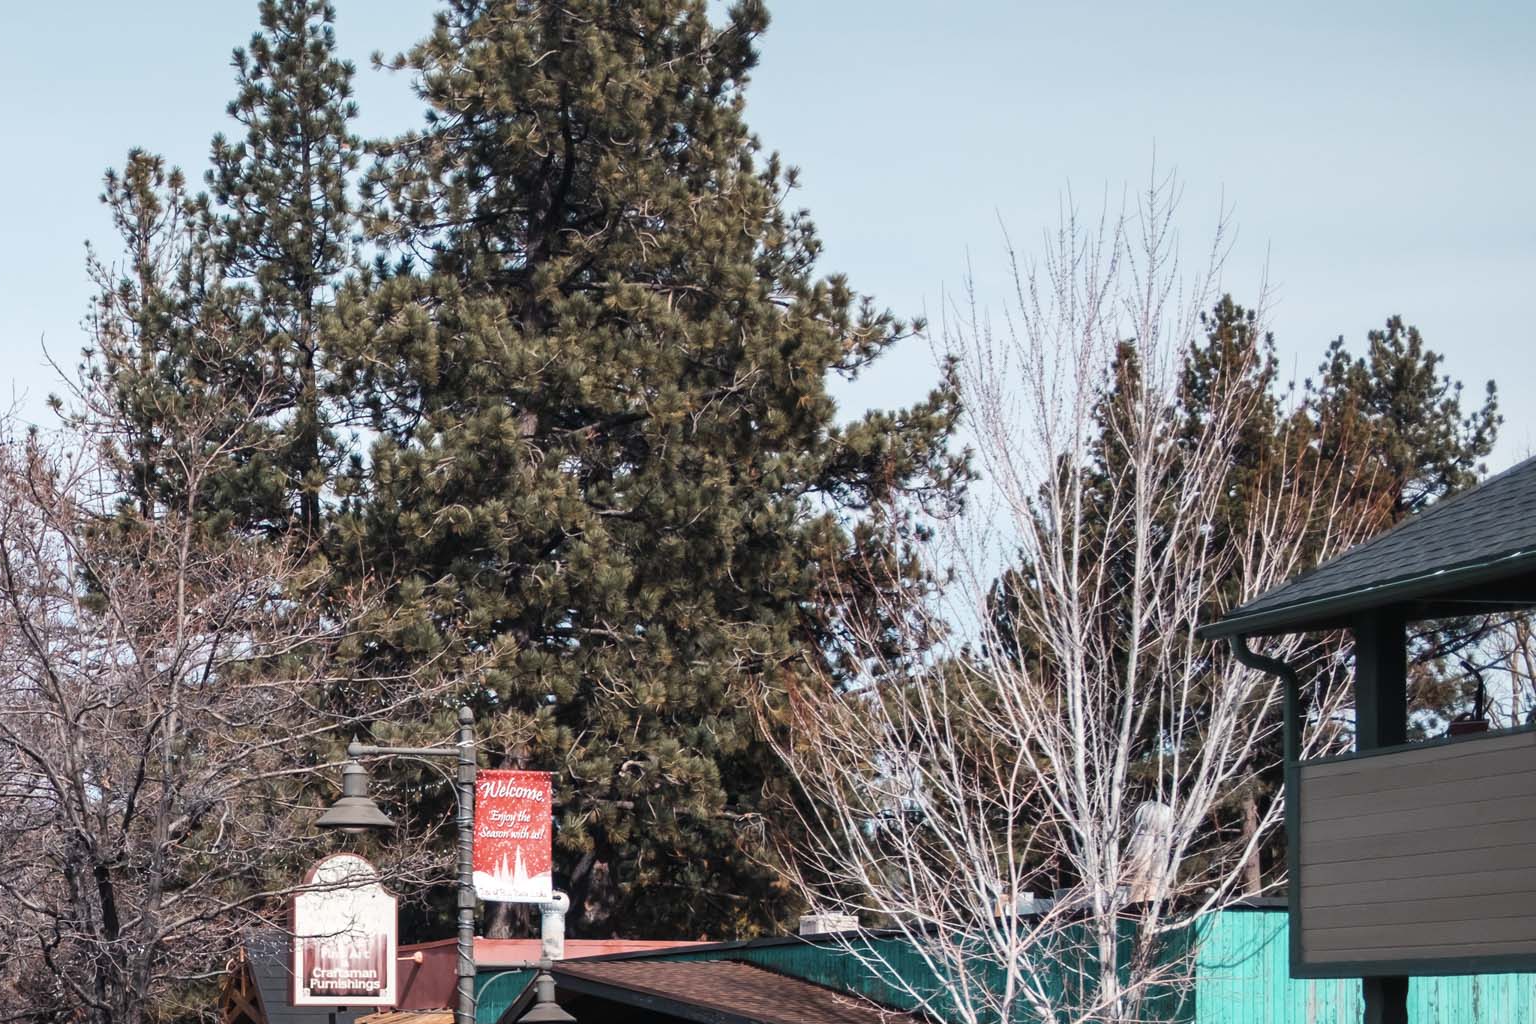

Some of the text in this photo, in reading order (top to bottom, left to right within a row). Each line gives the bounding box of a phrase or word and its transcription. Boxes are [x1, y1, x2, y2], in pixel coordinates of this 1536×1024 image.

[480, 778, 545, 802] Welcome
[489, 809, 530, 827] Enjoy the
[479, 825, 545, 839] Season with us!
[312, 967, 377, 978] Craftsman
[310, 978, 381, 991] Furnishings
